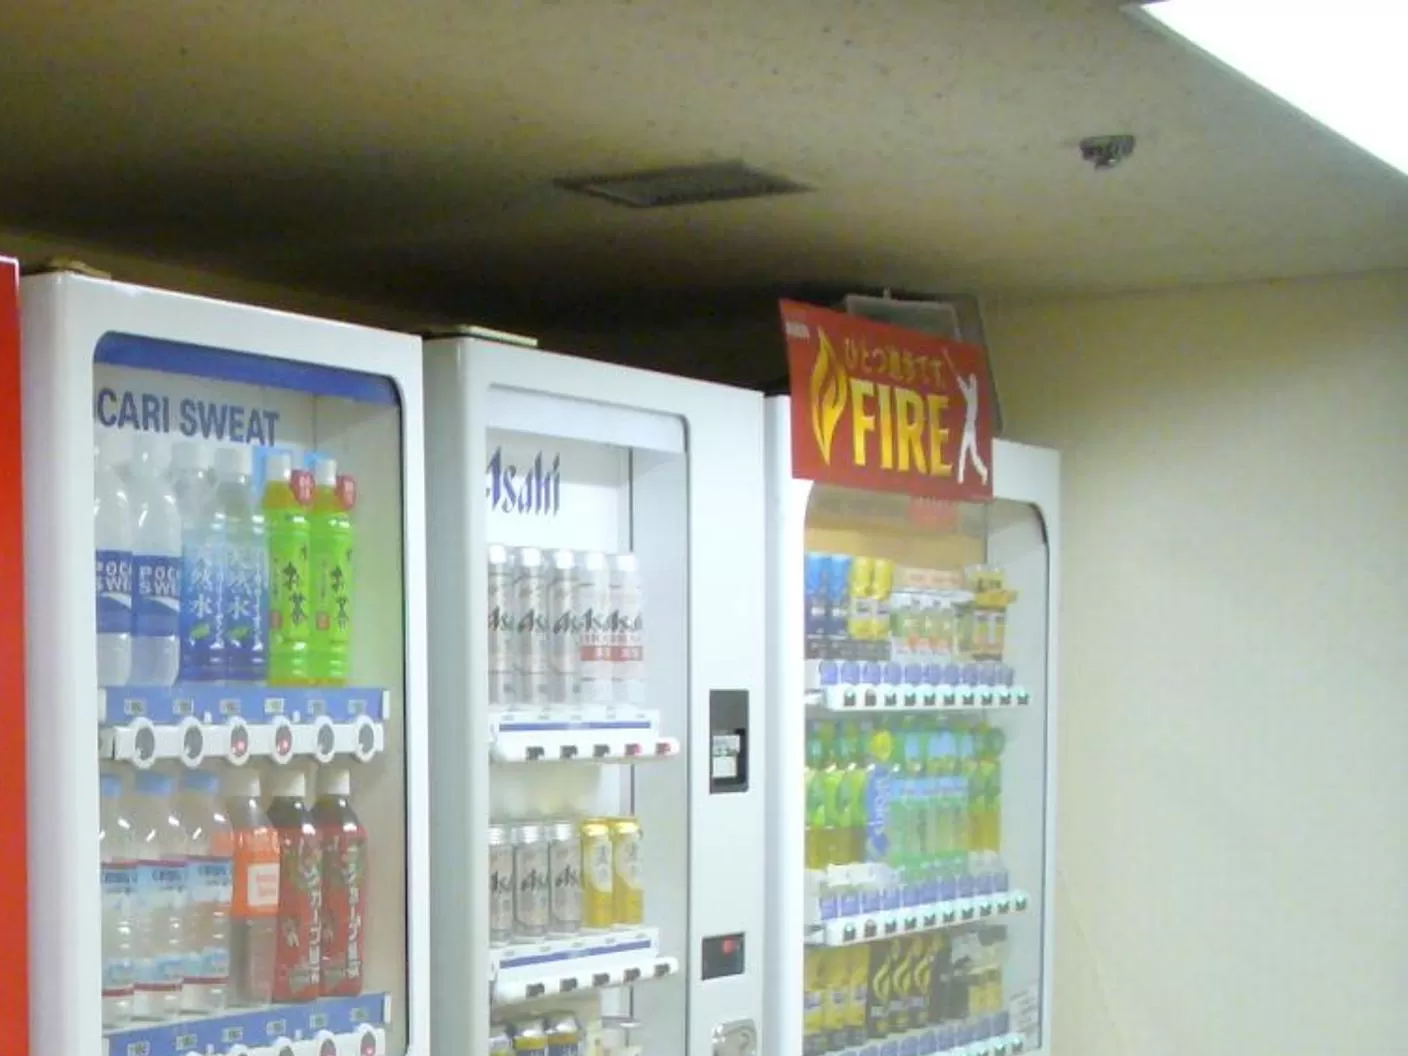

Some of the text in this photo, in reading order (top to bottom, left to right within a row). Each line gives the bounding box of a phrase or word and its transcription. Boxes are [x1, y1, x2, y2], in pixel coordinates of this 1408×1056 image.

[95, 387, 280, 446] CARI SWEAT
[849, 376, 954, 477] FIRE
[485, 445, 561, 518] Asahi
